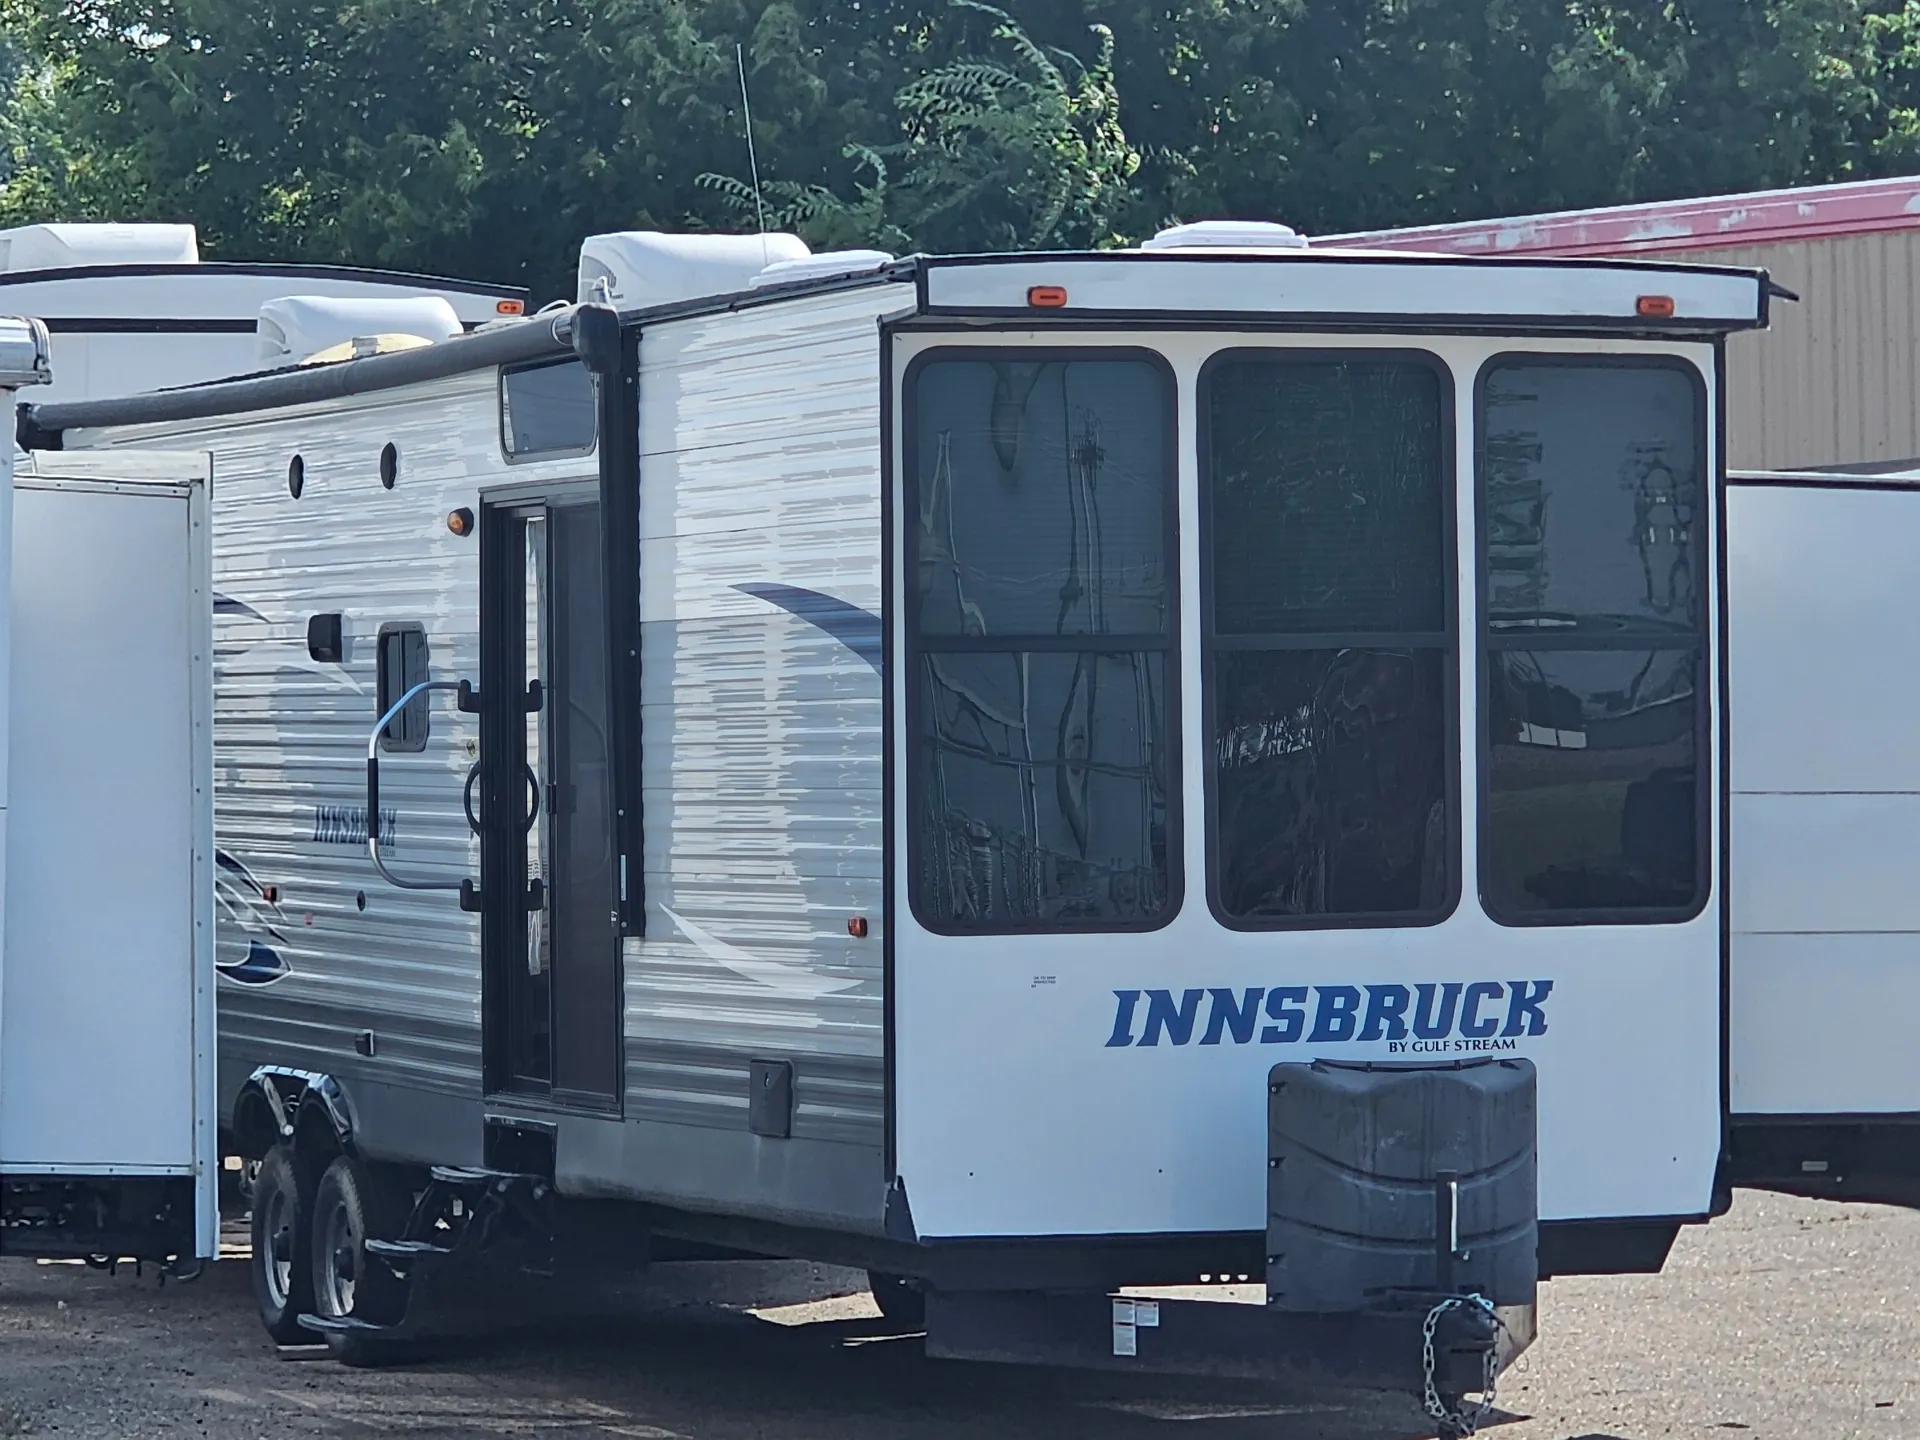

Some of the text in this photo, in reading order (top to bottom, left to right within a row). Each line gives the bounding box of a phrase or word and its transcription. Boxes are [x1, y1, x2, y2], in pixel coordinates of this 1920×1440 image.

[314, 805, 398, 846] INNSBRCK
[1104, 980, 1554, 1047] INNSBRUCK
[1389, 1039, 1516, 1053] BY GULF STREAM
